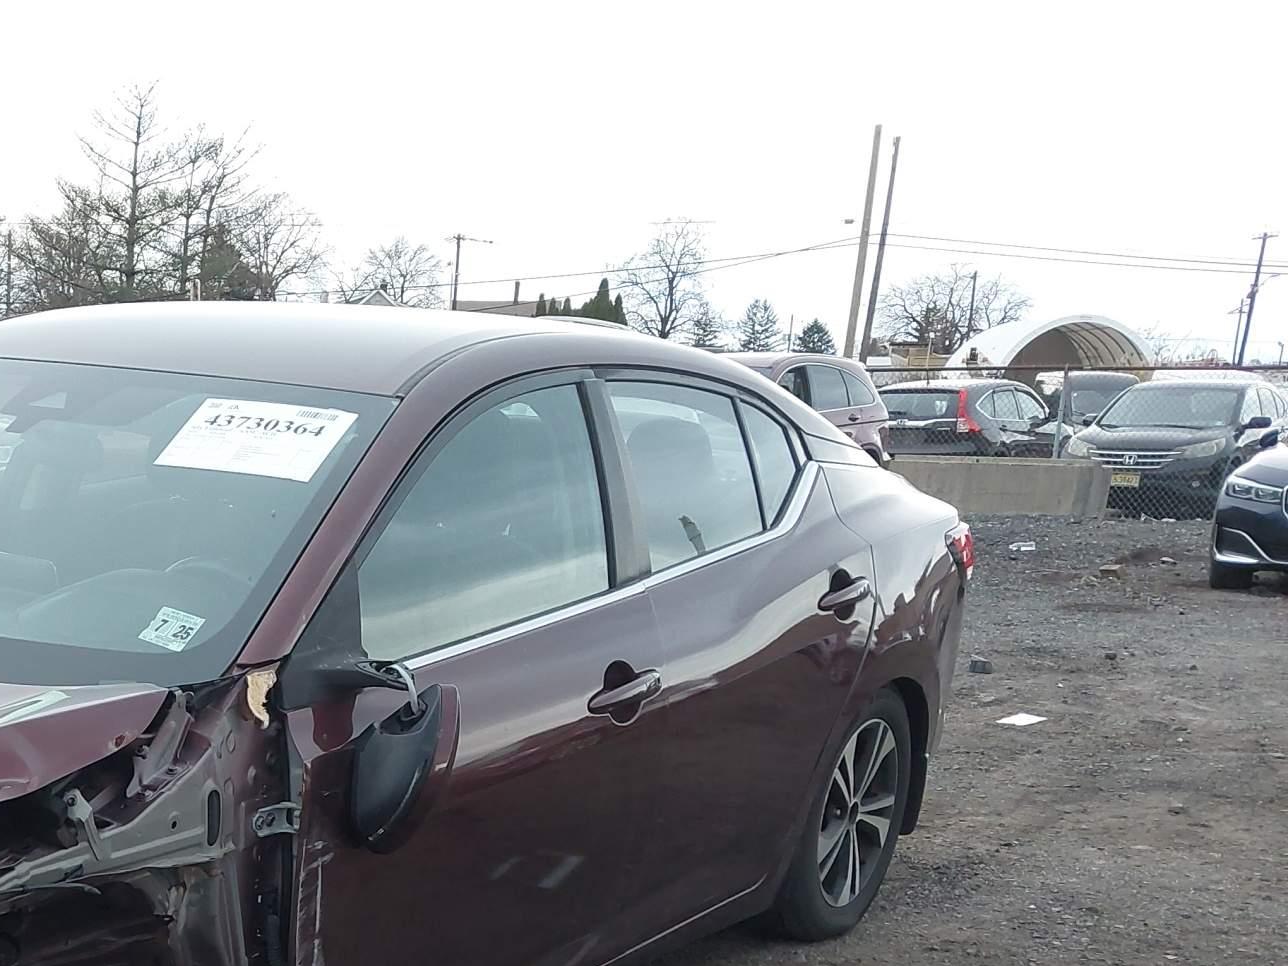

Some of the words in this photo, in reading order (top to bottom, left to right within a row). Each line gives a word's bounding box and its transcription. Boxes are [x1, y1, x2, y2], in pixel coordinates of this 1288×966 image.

[204, 414, 326, 437] 43730364
[154, 619, 170, 632] 7
[172, 624, 194, 640] 25
